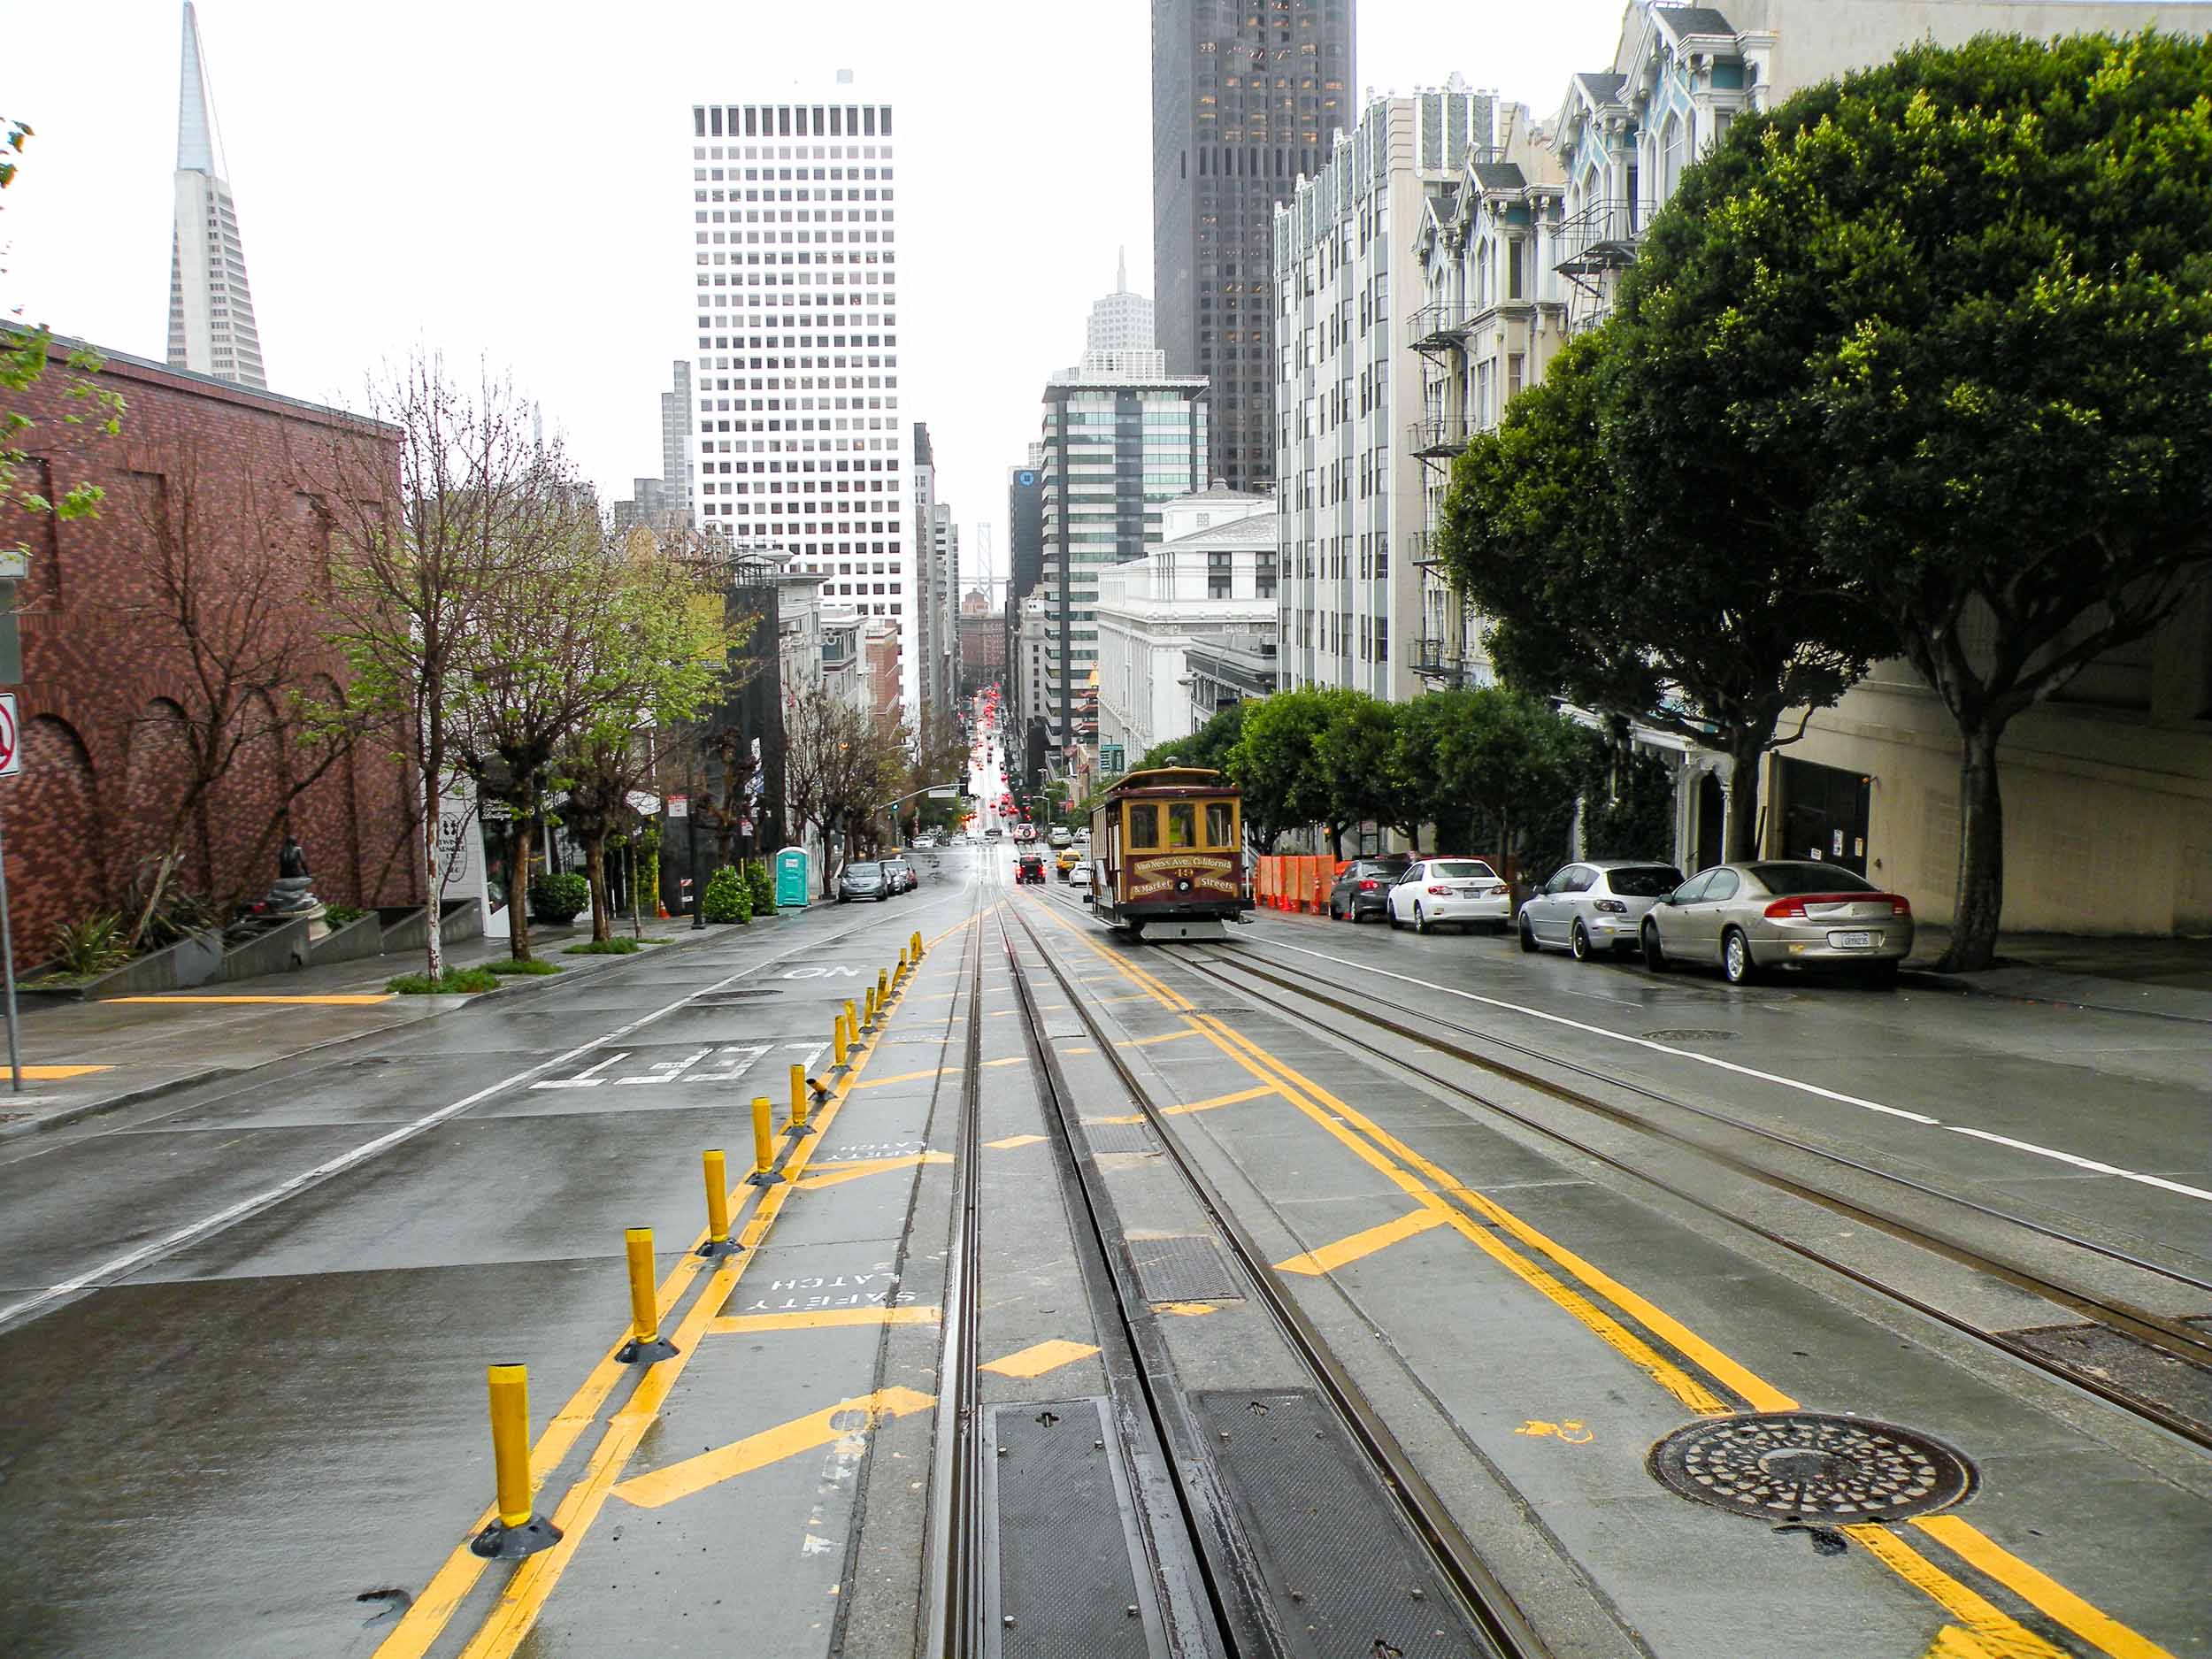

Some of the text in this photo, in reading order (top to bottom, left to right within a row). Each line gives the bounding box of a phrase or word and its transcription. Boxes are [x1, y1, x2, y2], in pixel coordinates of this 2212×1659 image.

[1193, 856, 1232, 868] California
[1141, 879, 1170, 893] Market
[1202, 878, 1233, 889] Streets
[528, 1041, 833, 1090] LEFT
[771, 1273, 900, 1291] LATCH
[746, 1291, 917, 1310] SAFETY
